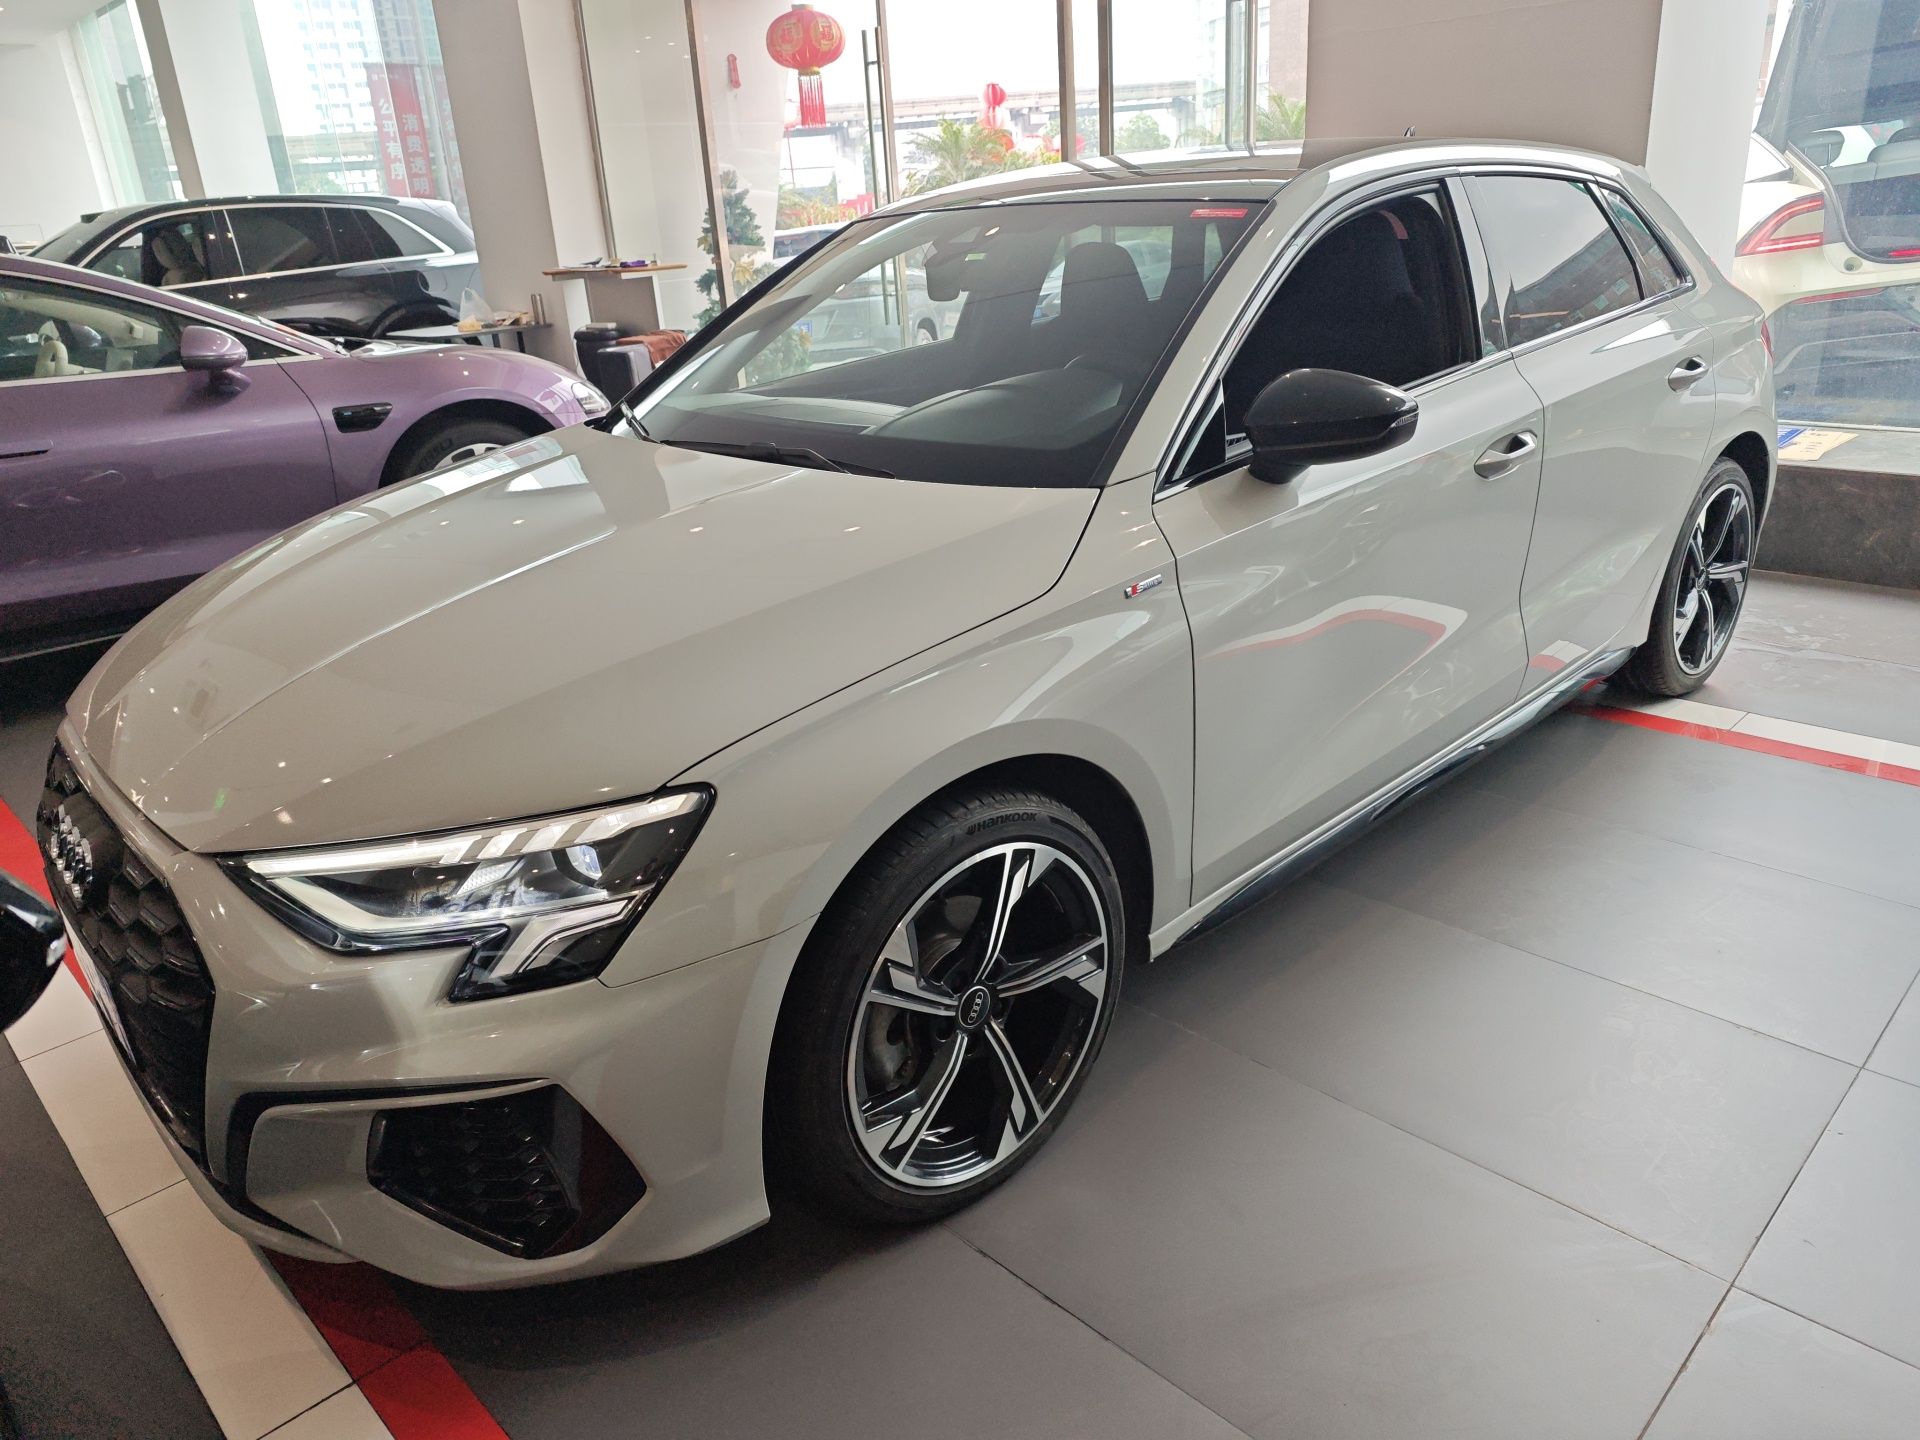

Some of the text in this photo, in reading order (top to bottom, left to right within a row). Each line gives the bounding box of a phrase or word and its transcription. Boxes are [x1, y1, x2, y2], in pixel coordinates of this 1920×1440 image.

[379, 98, 405, 180] 公平有序
[401, 113, 430, 194] 消费透明
